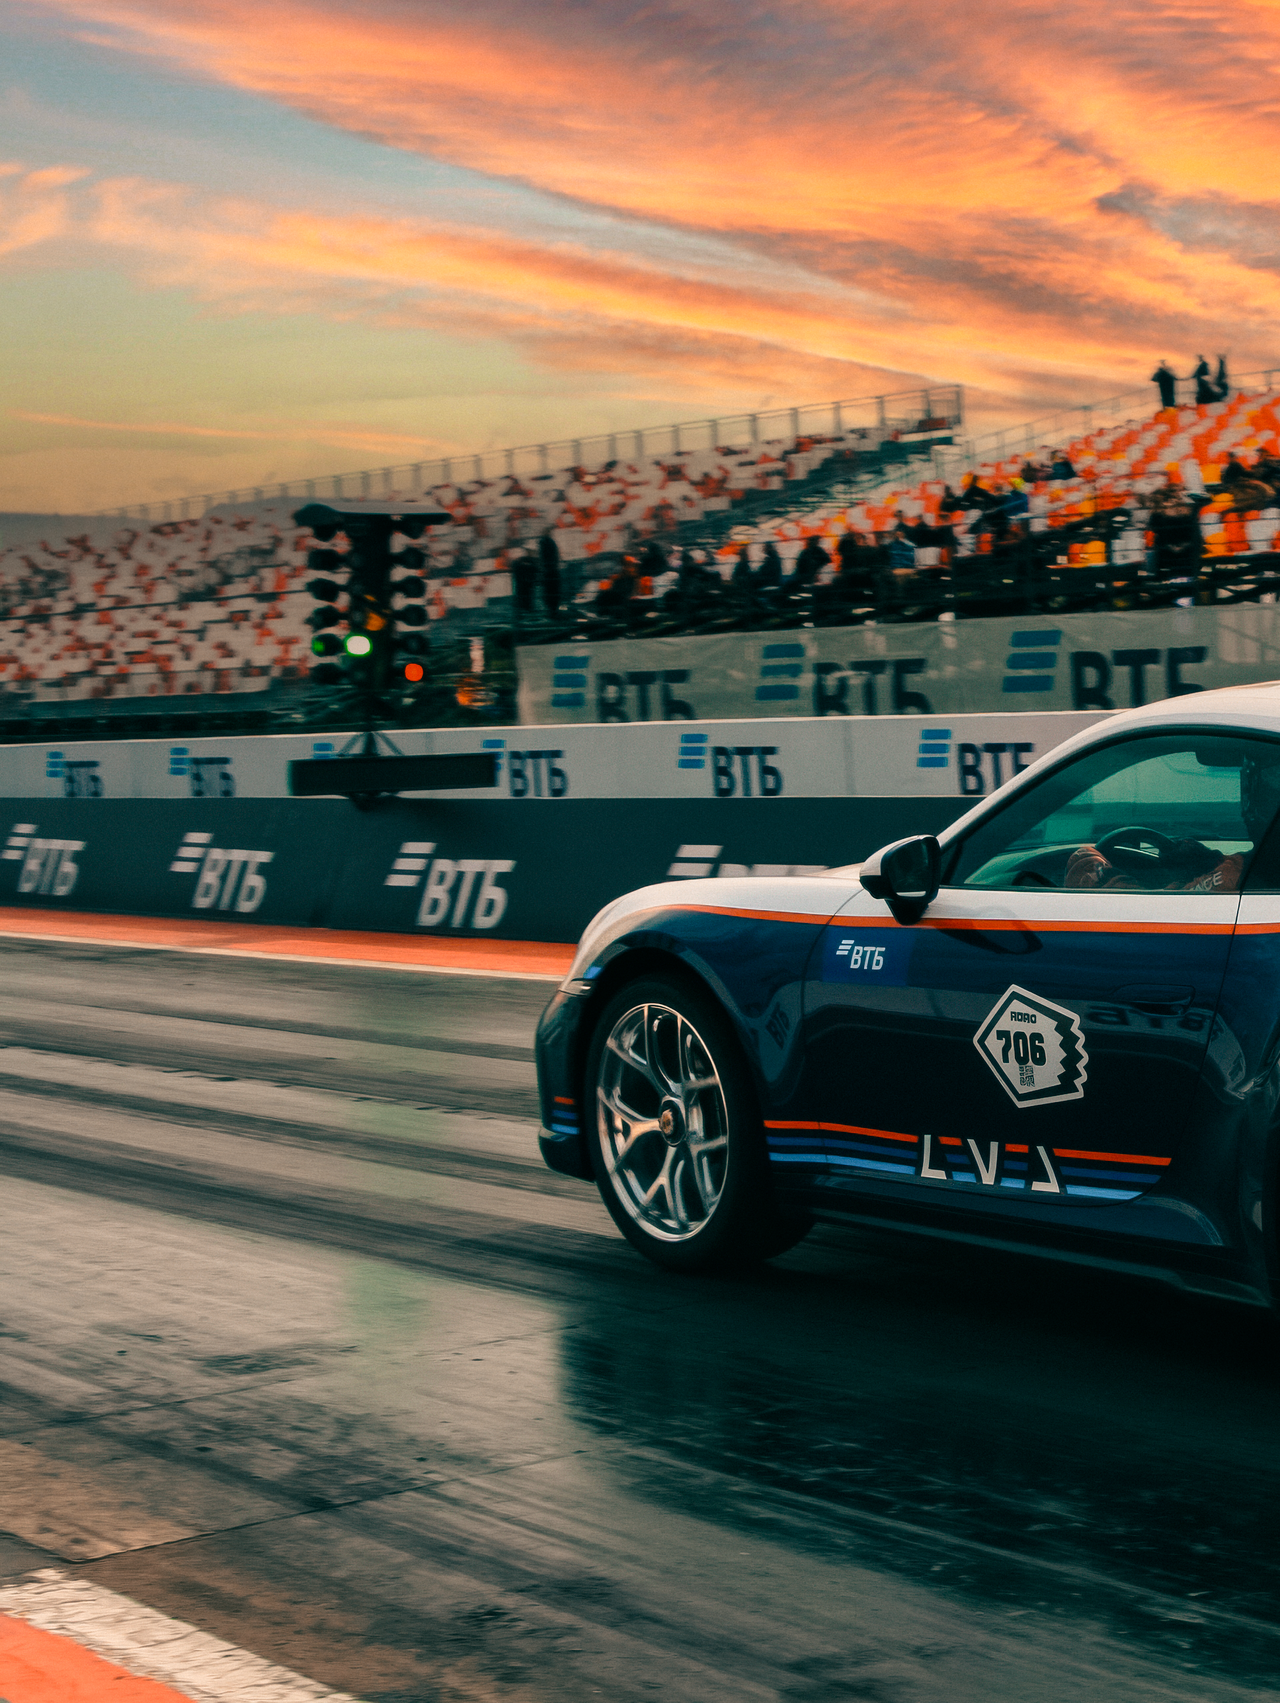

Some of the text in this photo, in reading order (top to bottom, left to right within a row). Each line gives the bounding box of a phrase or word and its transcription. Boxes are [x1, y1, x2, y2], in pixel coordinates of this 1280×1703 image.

[508, 750, 568, 797] ВТБ
[710, 746, 783, 797] ВТБ
[17, 838, 86, 895] ВТБ
[192, 848, 275, 912] ВТБ
[416, 859, 516, 928] ВТБ
[850, 945, 886, 971] ВТБ
[996, 1030, 1047, 1067] 706
